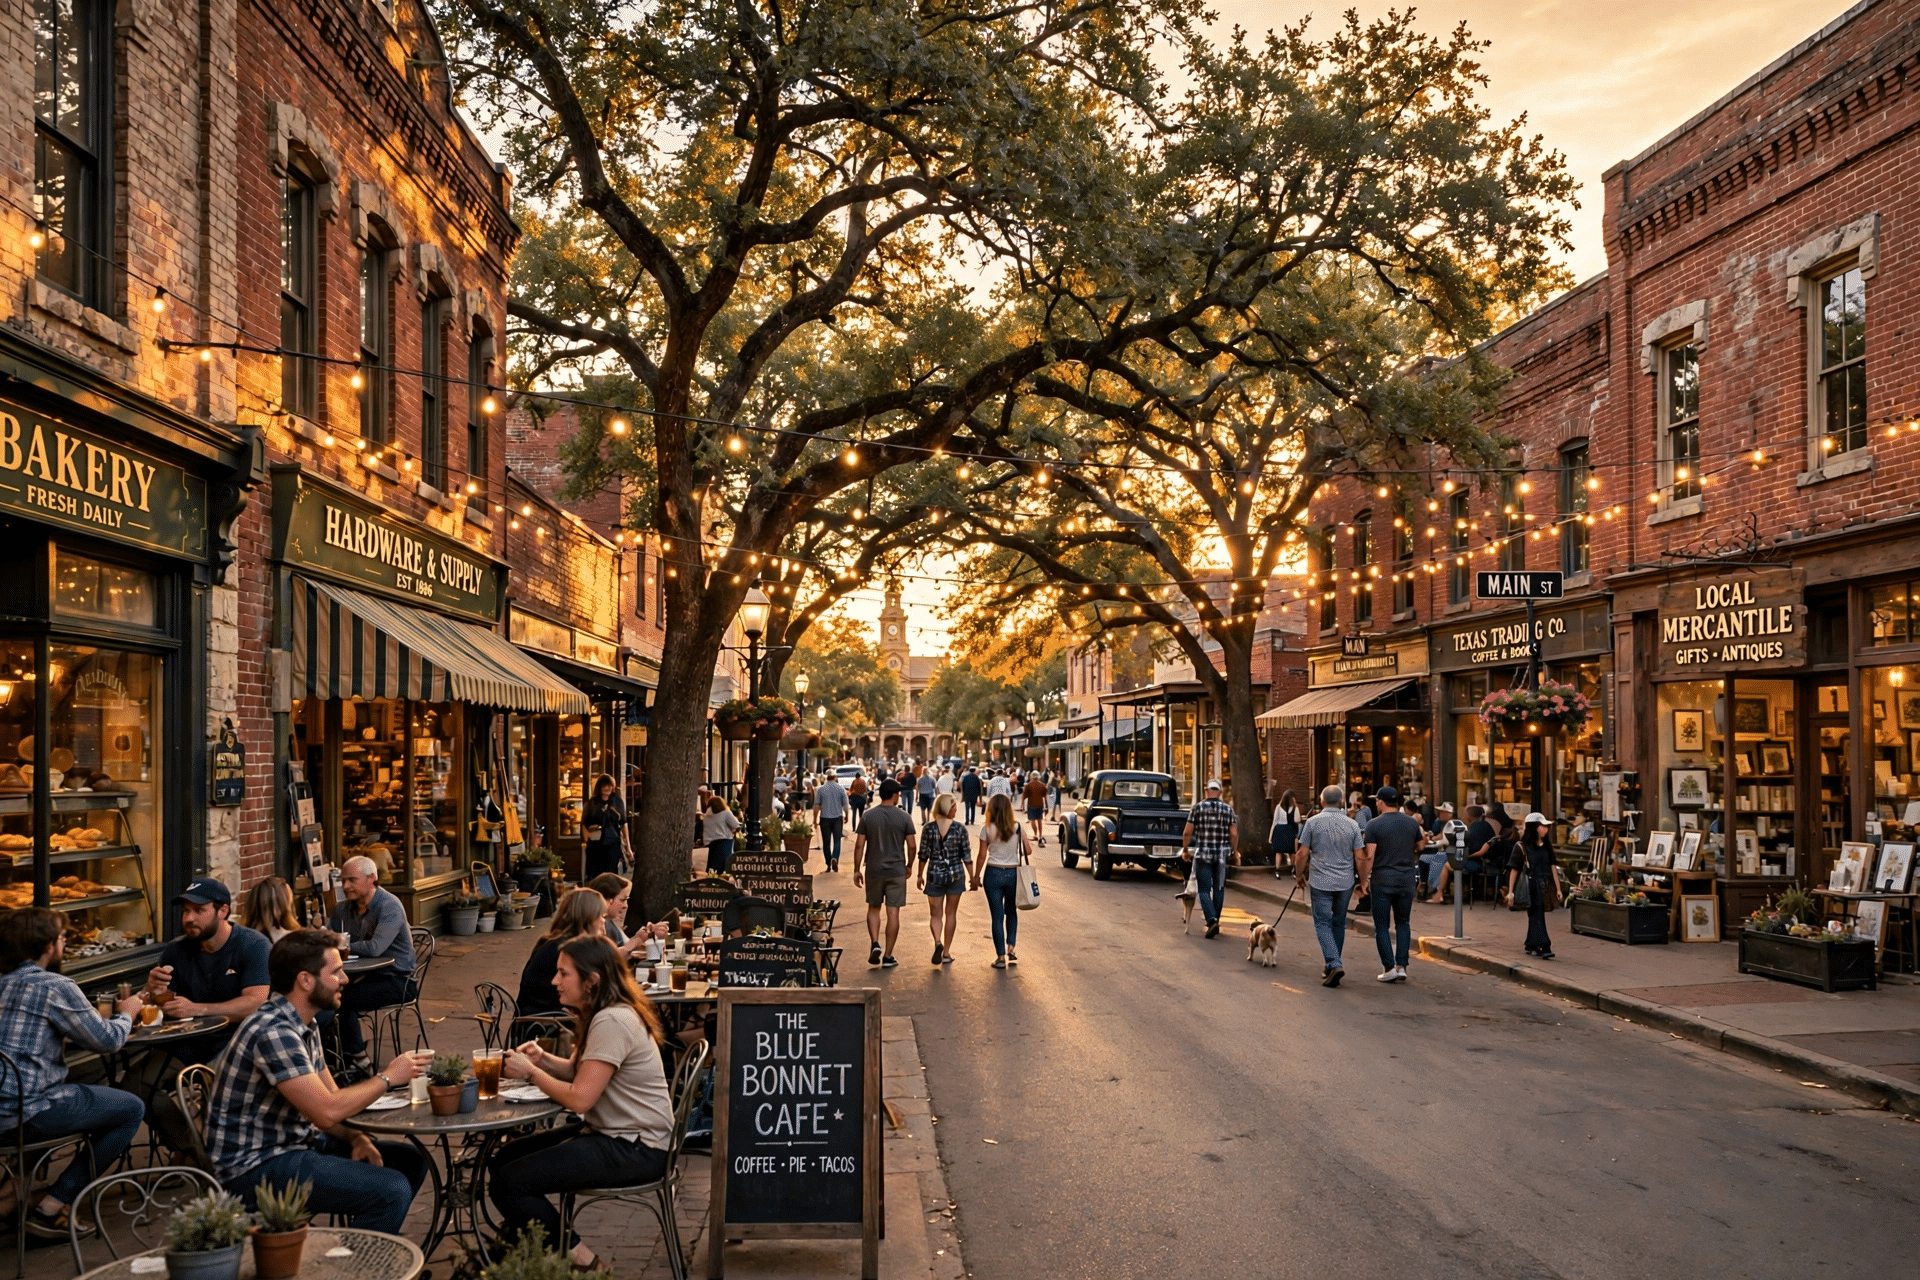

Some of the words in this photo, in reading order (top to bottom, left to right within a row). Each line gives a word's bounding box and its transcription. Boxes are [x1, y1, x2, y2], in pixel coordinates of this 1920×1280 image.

[0, 411, 156, 512] BAKERY
[27, 485, 77, 516] FRESH
[83, 504, 123, 528] DAILY
[324, 505, 422, 575] HARDWARE
[427, 548, 436, 580] &
[440, 552, 483, 596] SUPPLY
[396, 572, 412, 590] EST
[1488, 575, 1531, 595] MAIN
[1541, 581, 1553, 594] ST
[1695, 581, 1755, 609] LOCAL
[1453, 630, 1488, 651] TEXAS
[1547, 617, 1566, 638] CO.
[1663, 605, 1793, 643] MERCANTILE
[1472, 650, 1499, 663] COFFEE
[1501, 648, 1507, 659] &
[1510, 645, 1533, 658] BOOK
[1675, 648, 1709, 665] GIFTS
[1722, 641, 1783, 662] ANTIQUES
[775, 1013, 808, 1029] THE
[756, 1031, 820, 1060] BLUE
[742, 1064, 852, 1096] BONNET
[755, 1102, 829, 1135] CAFE
[735, 1156, 776, 1174] COFFEE
[789, 1156, 807, 1173] PIE
[819, 1156, 855, 1173] TACOS
